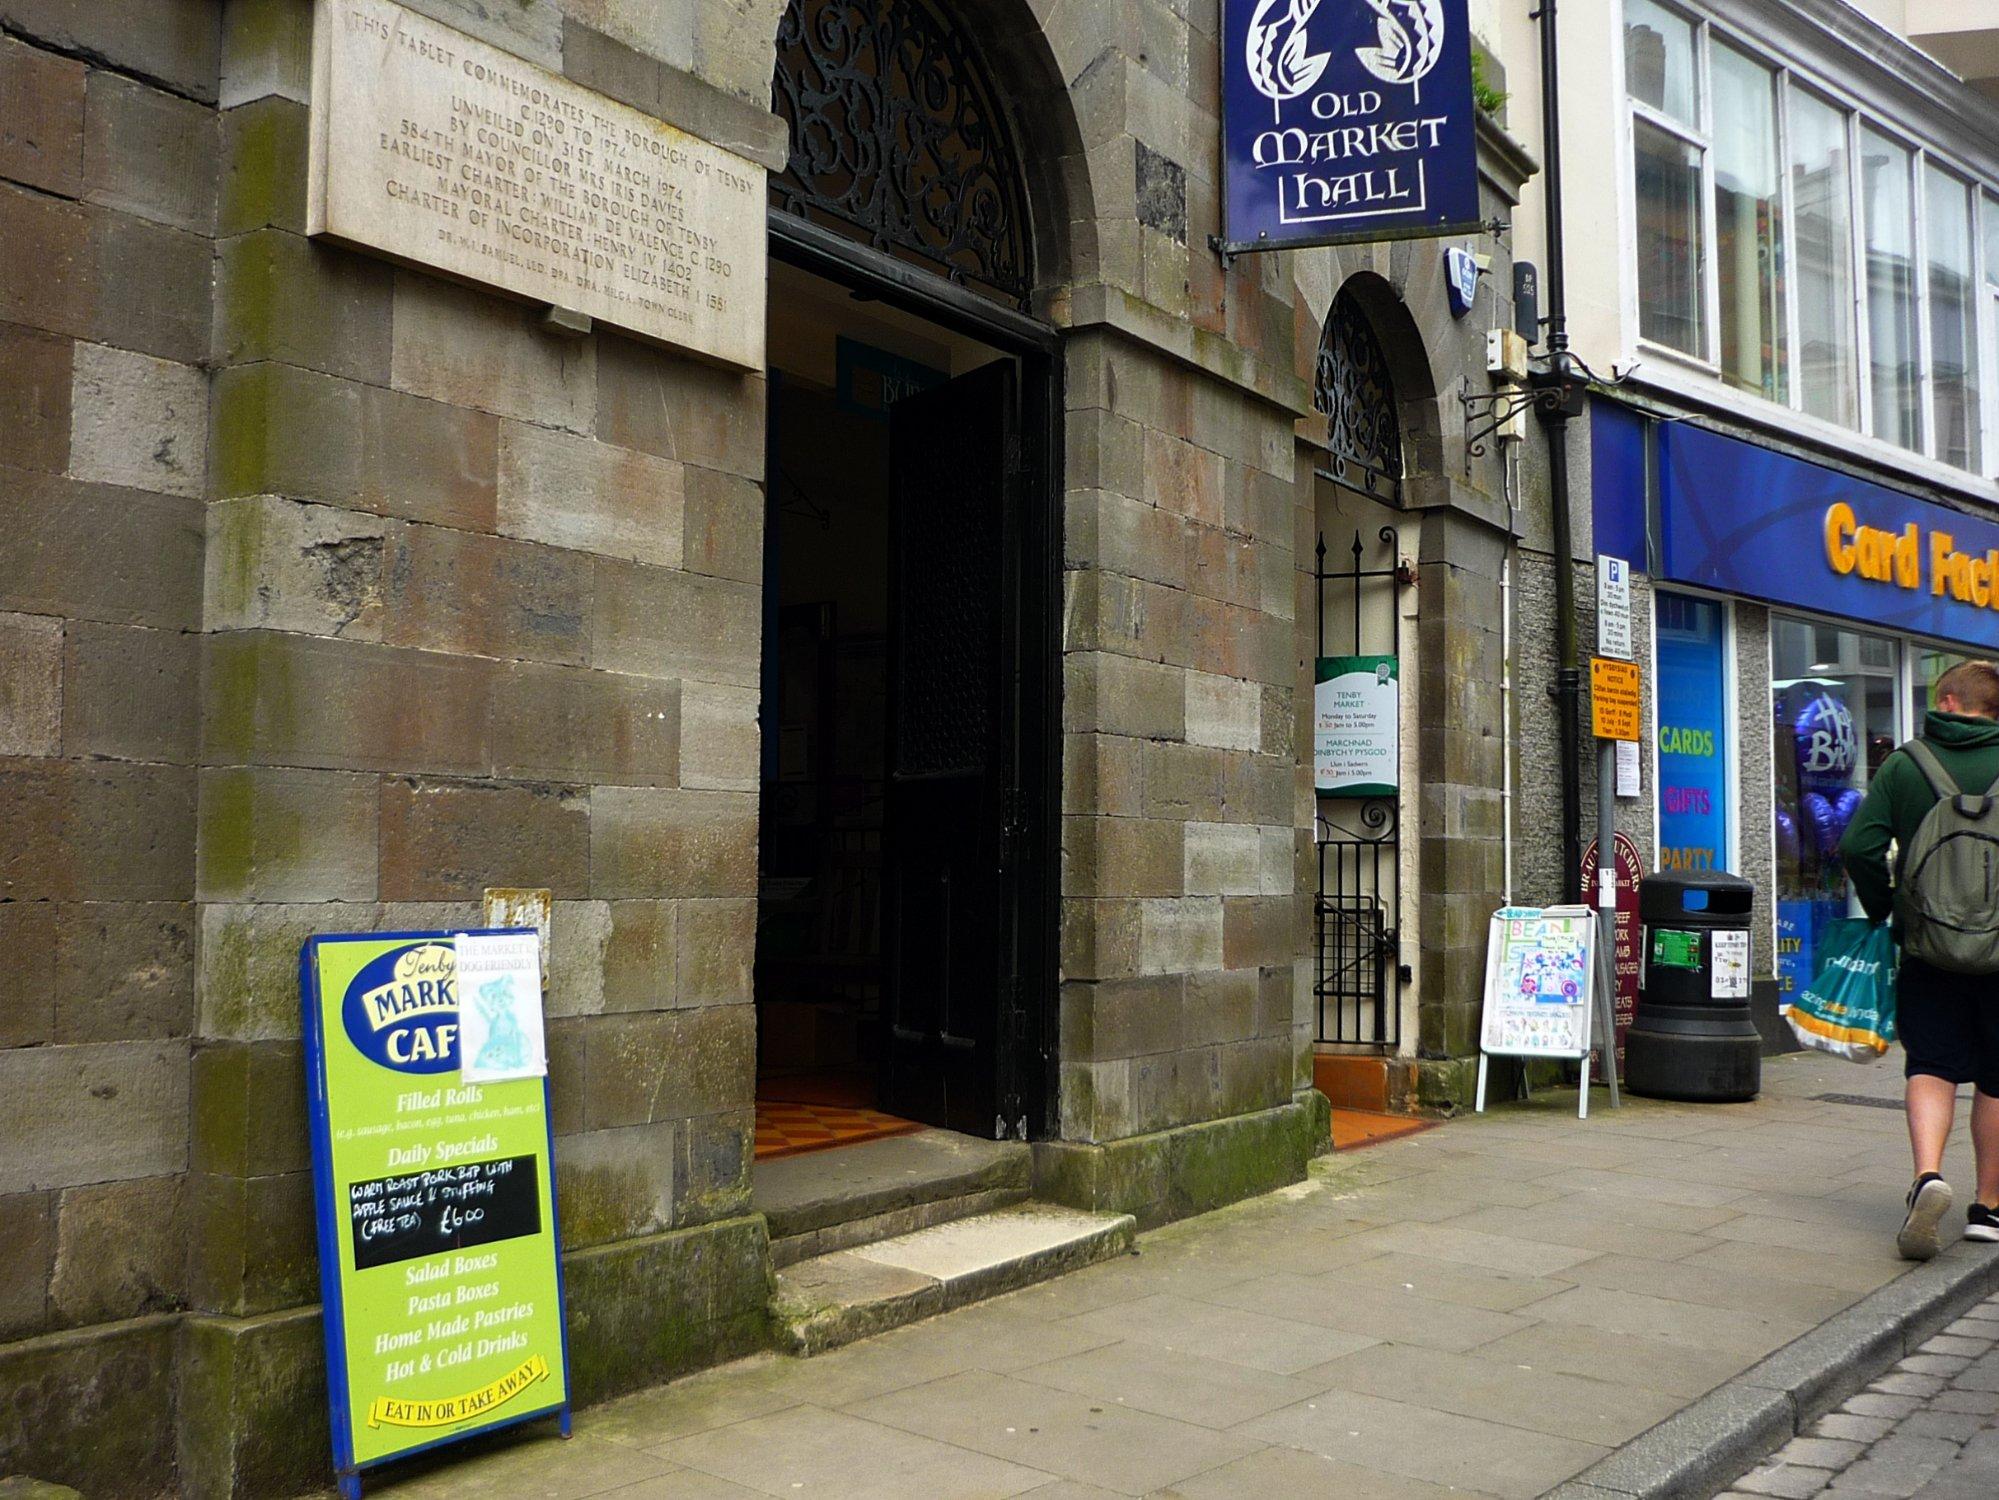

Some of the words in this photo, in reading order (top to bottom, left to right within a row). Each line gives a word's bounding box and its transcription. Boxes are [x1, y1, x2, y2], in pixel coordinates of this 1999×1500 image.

[352, 11, 389, 40] THIS
[397, 31, 455, 67] TABLET
[463, 60, 585, 123] COMMEMORATES
[592, 114, 616, 137] THE
[625, 129, 687, 168] BOROUGH
[695, 160, 710, 176] OF
[717, 168, 754, 195] TENBY
[1311, 90, 1381, 119] OLD
[452, 95, 524, 137] UNVEILED
[532, 127, 554, 148] ON
[604, 159, 650, 188] MARCH
[658, 178, 683, 201] 1974
[573, 126, 592, 145] TO
[600, 138, 626, 158] 1974
[1252, 115, 1447, 169] MARKET
[450, 116, 470, 136] BY
[477, 128, 571, 178] COUNCILLOR
[579, 168, 604, 190] MRS
[611, 181, 635, 202] IRIS
[641, 192, 684, 222] DAVIES
[380, 133, 453, 173] EARLIEST
[540, 193, 598, 227] WILLIAM
[606, 218, 621, 237] DE
[629, 226, 684, 260] VALENCE
[462, 142, 515, 178] MAYOR
[524, 167, 542, 186] OF
[550, 176, 576, 199] THE
[583, 189, 650, 227] BOROUGH
[656, 218, 672, 236] OF
[678, 226, 717, 253] TENBY
[386, 179, 459, 219] CHARTER
[469, 209, 488, 228] OF
[496, 217, 614, 271] INCORPORATION
[624, 263, 690, 300] ELIZABETH
[706, 294, 727, 312] 1581
[437, 176, 512, 216] MAYORAL
[594, 233, 636, 260] HENRY
[643, 252, 656, 266] IV
[662, 259, 691, 281] 1402
[638, 297, 664, 313] TOWN
[1825, 501, 1920, 589] Card
[1333, 700, 1364, 708] MARKET
[1336, 691, 1361, 699] TENBY
[1352, 712, 1377, 720] Saturday
[1354, 748, 1387, 756] PYSGOD
[1659, 726, 1714, 757] CARDS
[1664, 786, 1711, 815] GIFTS
[1614, 840, 1640, 892] UTCHERS
[1661, 847, 1715, 871] PARTY
[459, 945, 480, 957] THE
[482, 943, 526, 956] MARKET
[1615, 928, 1628, 941] ORK
[1615, 945, 1630, 957] AMB
[403, 942, 457, 982] Tenby
[460, 960, 483, 972] DOG
[485, 957, 532, 971] FRIENDLY
[375, 977, 458, 1023] MARK
[1615, 995, 1632, 1009] EATS
[387, 1024, 458, 1063] CAF
[397, 1089, 440, 1113] Filled
[446, 1086, 483, 1108] Rolls
[357, 1122, 393, 1137] sausage,
[396, 1118, 424, 1132] bacon,
[446, 1111, 467, 1125] tuna,
[469, 1108, 502, 1122] chicken,
[503, 1105, 523, 1116] ham,
[387, 1144, 432, 1167] Daily
[435, 1132, 498, 1162] Specials
[351, 1182, 383, 1200] WARM
[386, 1175, 420, 1192] ROAST
[421, 1169, 457, 1187] PORK
[457, 1165, 480, 1179] BAP
[486, 1159, 512, 1176] WITH
[353, 1202, 386, 1218] APPLE
[390, 1191, 425, 1211] SAUCE
[441, 1179, 496, 1200] STUFFING
[362, 1218, 396, 1240] (FREE
[397, 1210, 421, 1230] TEA)
[406, 1257, 450, 1286] Salad
[454, 1252, 498, 1276] Boxes
[408, 1290, 451, 1316] Pasta
[456, 1281, 499, 1304] Boxes
[375, 1328, 422, 1355] Home
[427, 1314, 469, 1341] Made
[474, 1302, 534, 1329] Pastries
[386, 1359, 414, 1383] Hot
[420, 1355, 432, 1373] &
[437, 1341, 472, 1368] Cold
[477, 1330, 528, 1359] Drinks
[385, 1401, 414, 1420] EAT
[417, 1404, 432, 1420] IN
[436, 1402, 455, 1420] OR
[458, 1388, 495, 1415] TAKE
[498, 1361, 535, 1398] AWAY
